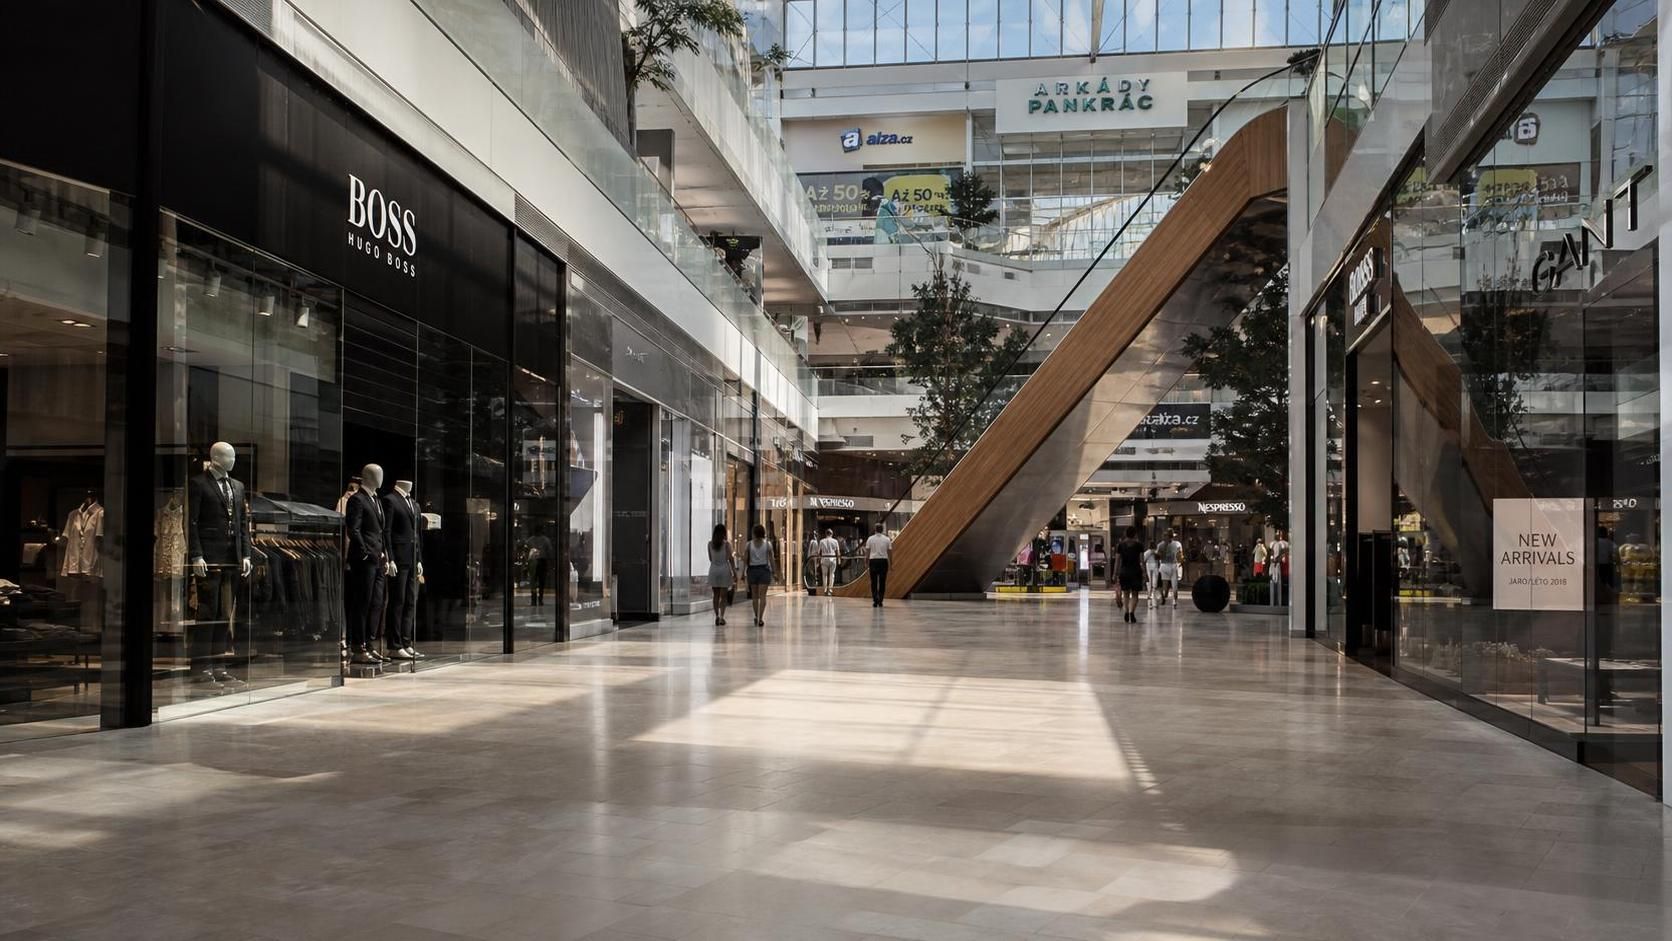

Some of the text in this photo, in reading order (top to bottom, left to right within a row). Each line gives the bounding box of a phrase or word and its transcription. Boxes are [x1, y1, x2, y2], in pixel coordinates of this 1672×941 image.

[1034, 76, 1150, 96] ARKÁDY
[1028, 93, 1153, 114] PANKRÁC
[866, 131, 914, 146] alza.cz
[347, 173, 417, 256] BOSS
[1532, 165, 1653, 295] GANT
[348, 231, 416, 278] HUGO BOSS
[1197, 502, 1246, 513] NESPRESSO
[1519, 533, 1557, 548] NEW
[1500, 551, 1575, 565] ARRIVALS
